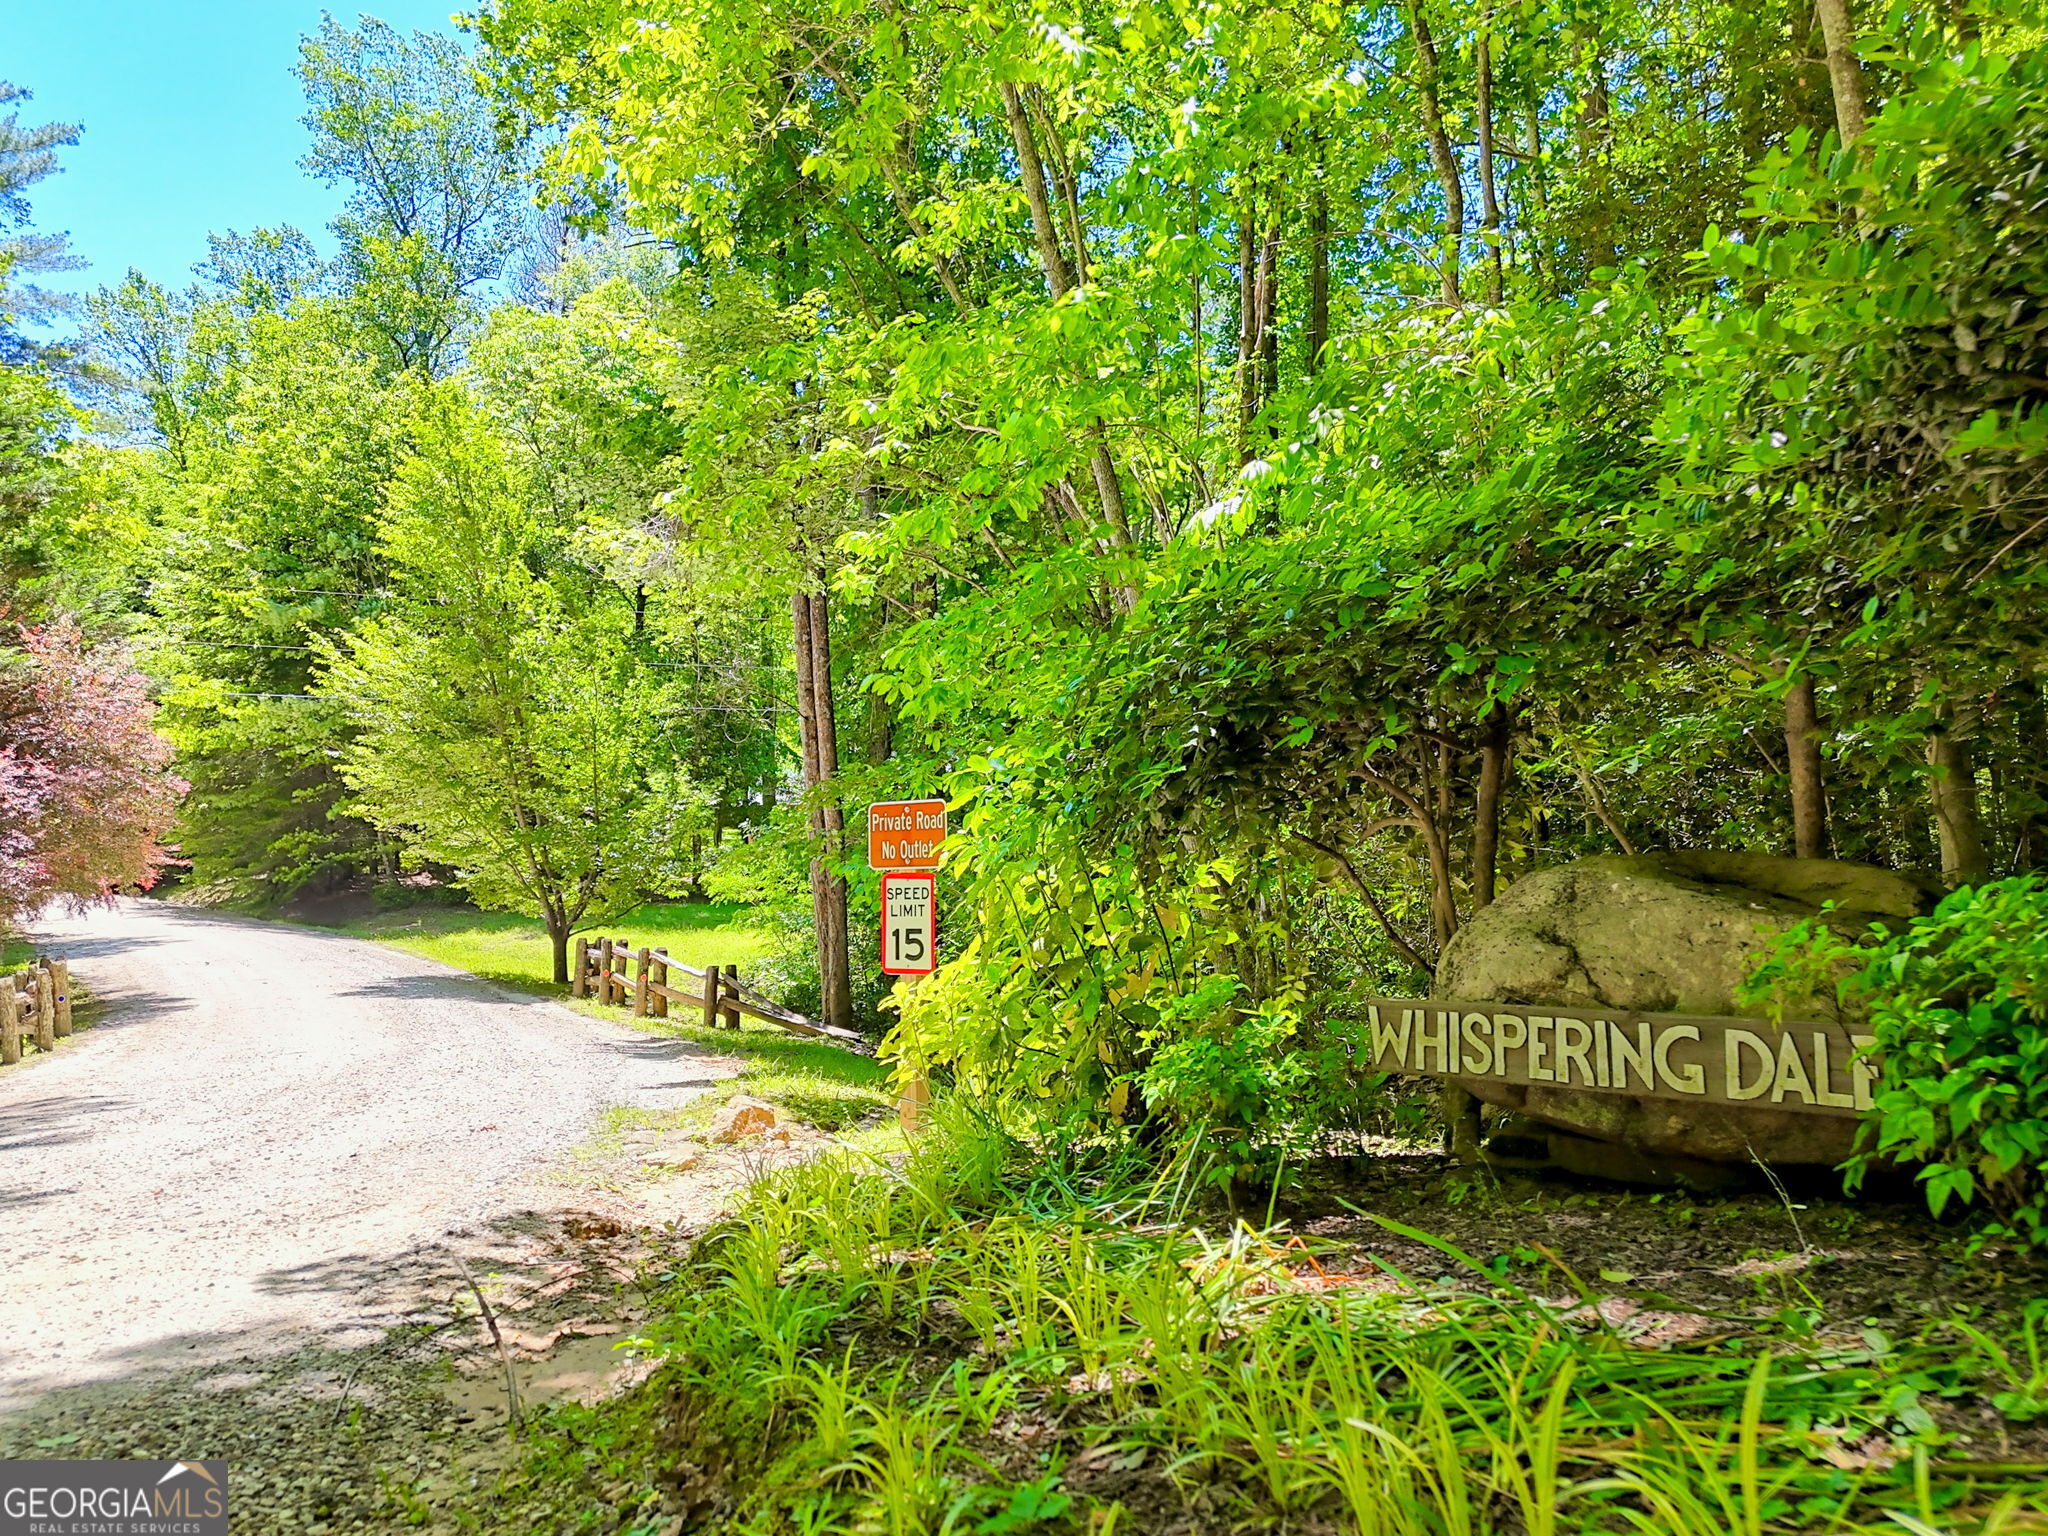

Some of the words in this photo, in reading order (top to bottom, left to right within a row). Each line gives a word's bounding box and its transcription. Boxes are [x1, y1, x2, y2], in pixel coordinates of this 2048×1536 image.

[872, 812, 912, 832] Private
[916, 811, 943, 830] Road
[882, 840, 896, 859] No
[887, 887, 929, 900] SPEED
[890, 904, 925, 917] LIMIT
[892, 928, 925, 961] 15
[1368, 1005, 1706, 1095] WHISPERING
